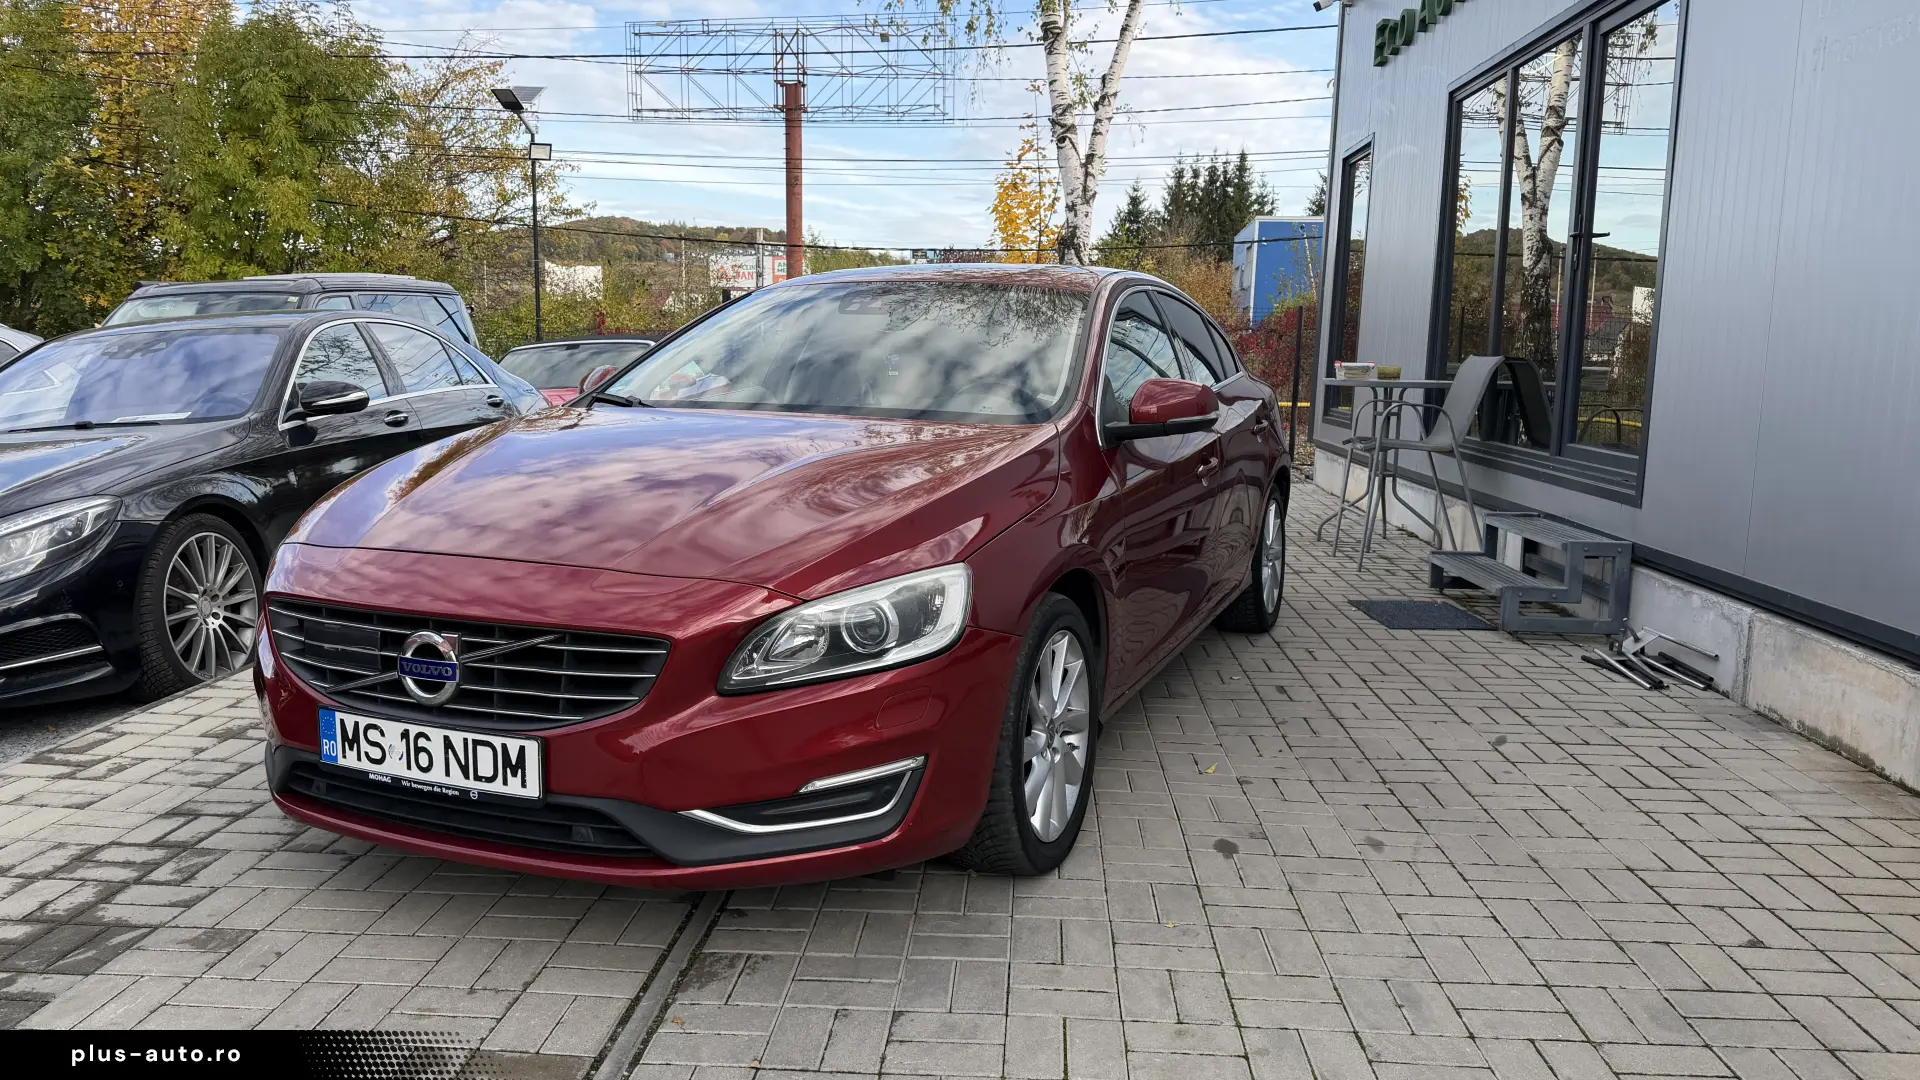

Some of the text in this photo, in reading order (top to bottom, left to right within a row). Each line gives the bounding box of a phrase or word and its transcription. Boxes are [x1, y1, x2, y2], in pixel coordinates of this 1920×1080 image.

[401, 661, 453, 677] VOLVO
[323, 739, 337, 757] RO
[339, 717, 528, 789] MS 16 NDM
[368, 772, 392, 783] MOHAG
[401, 780, 460, 797] Wir bewegen die Region
